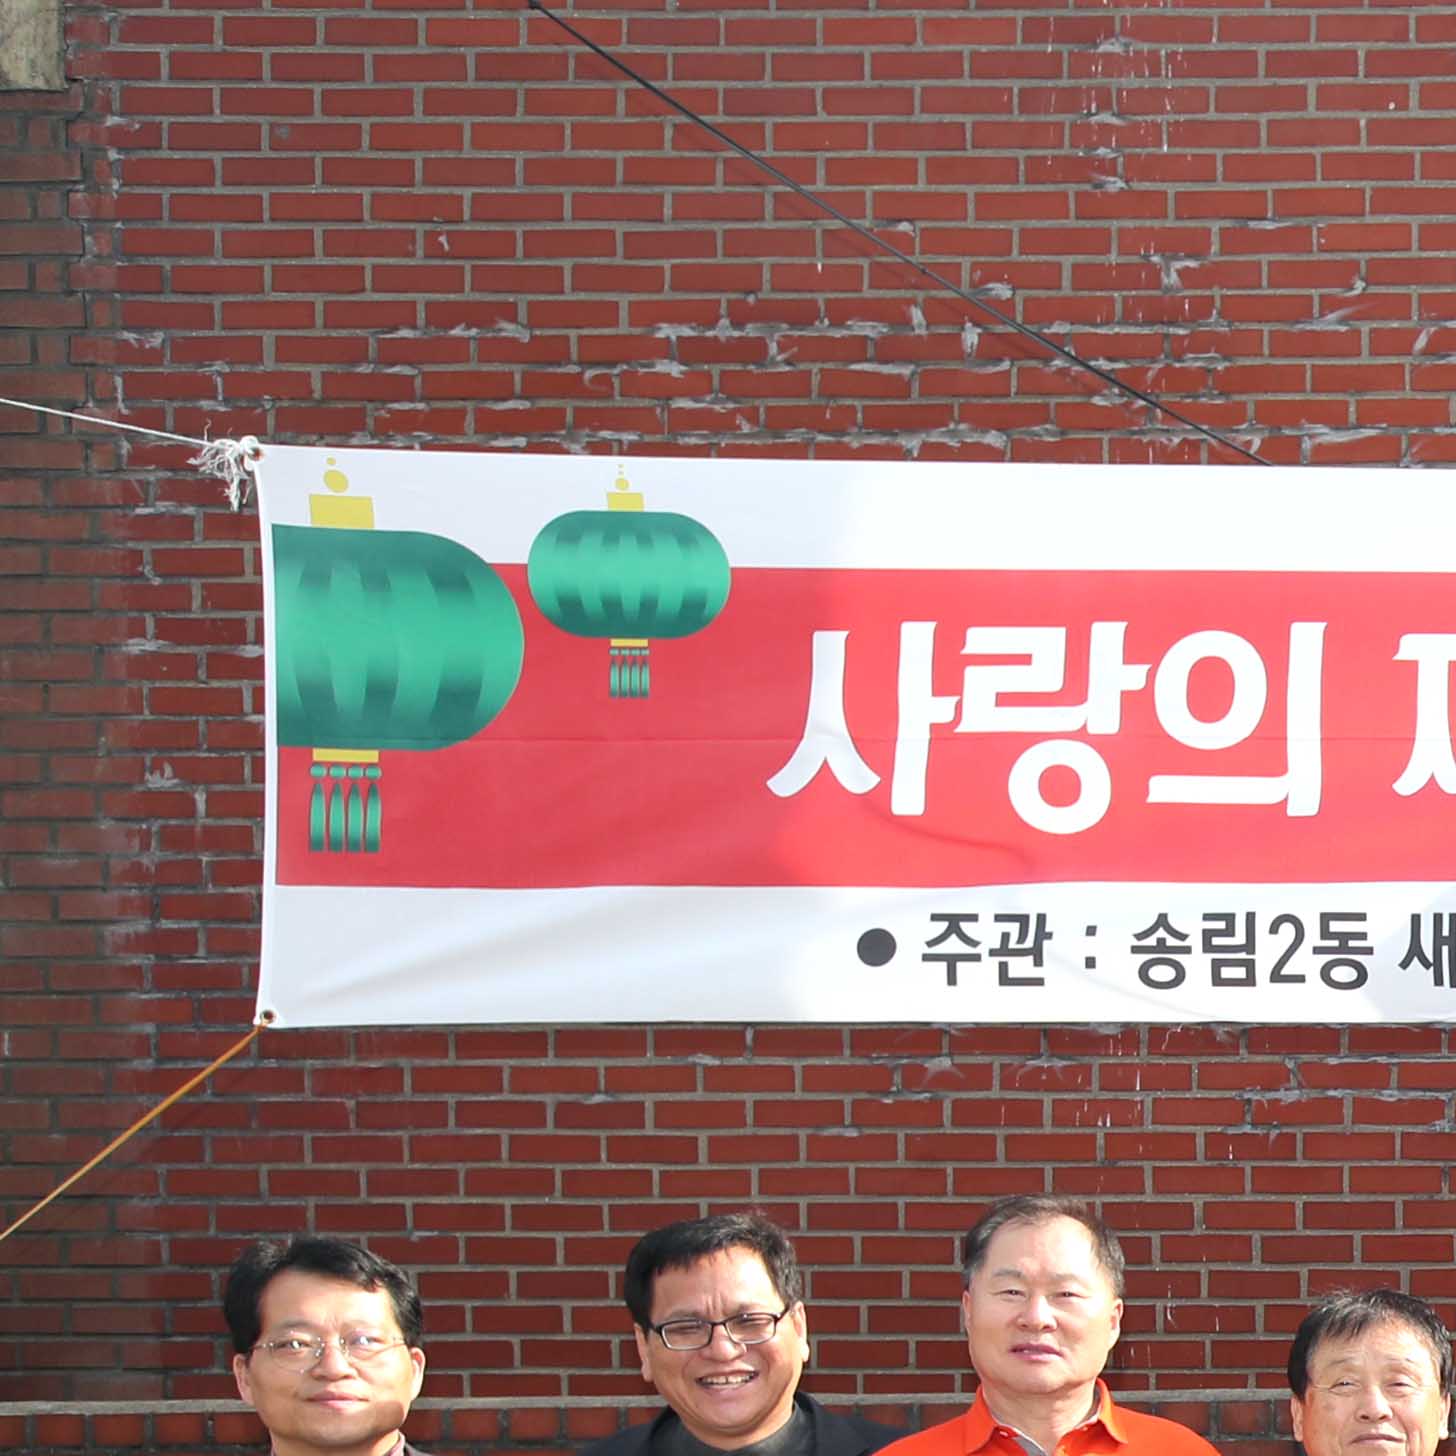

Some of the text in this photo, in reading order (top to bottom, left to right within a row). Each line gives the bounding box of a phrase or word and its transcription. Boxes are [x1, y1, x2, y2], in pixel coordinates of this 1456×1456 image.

[767, 622, 1327, 834] 사랑의
[922, 913, 1053, 986] 주관
[1131, 912, 1374, 990] 송림2동
